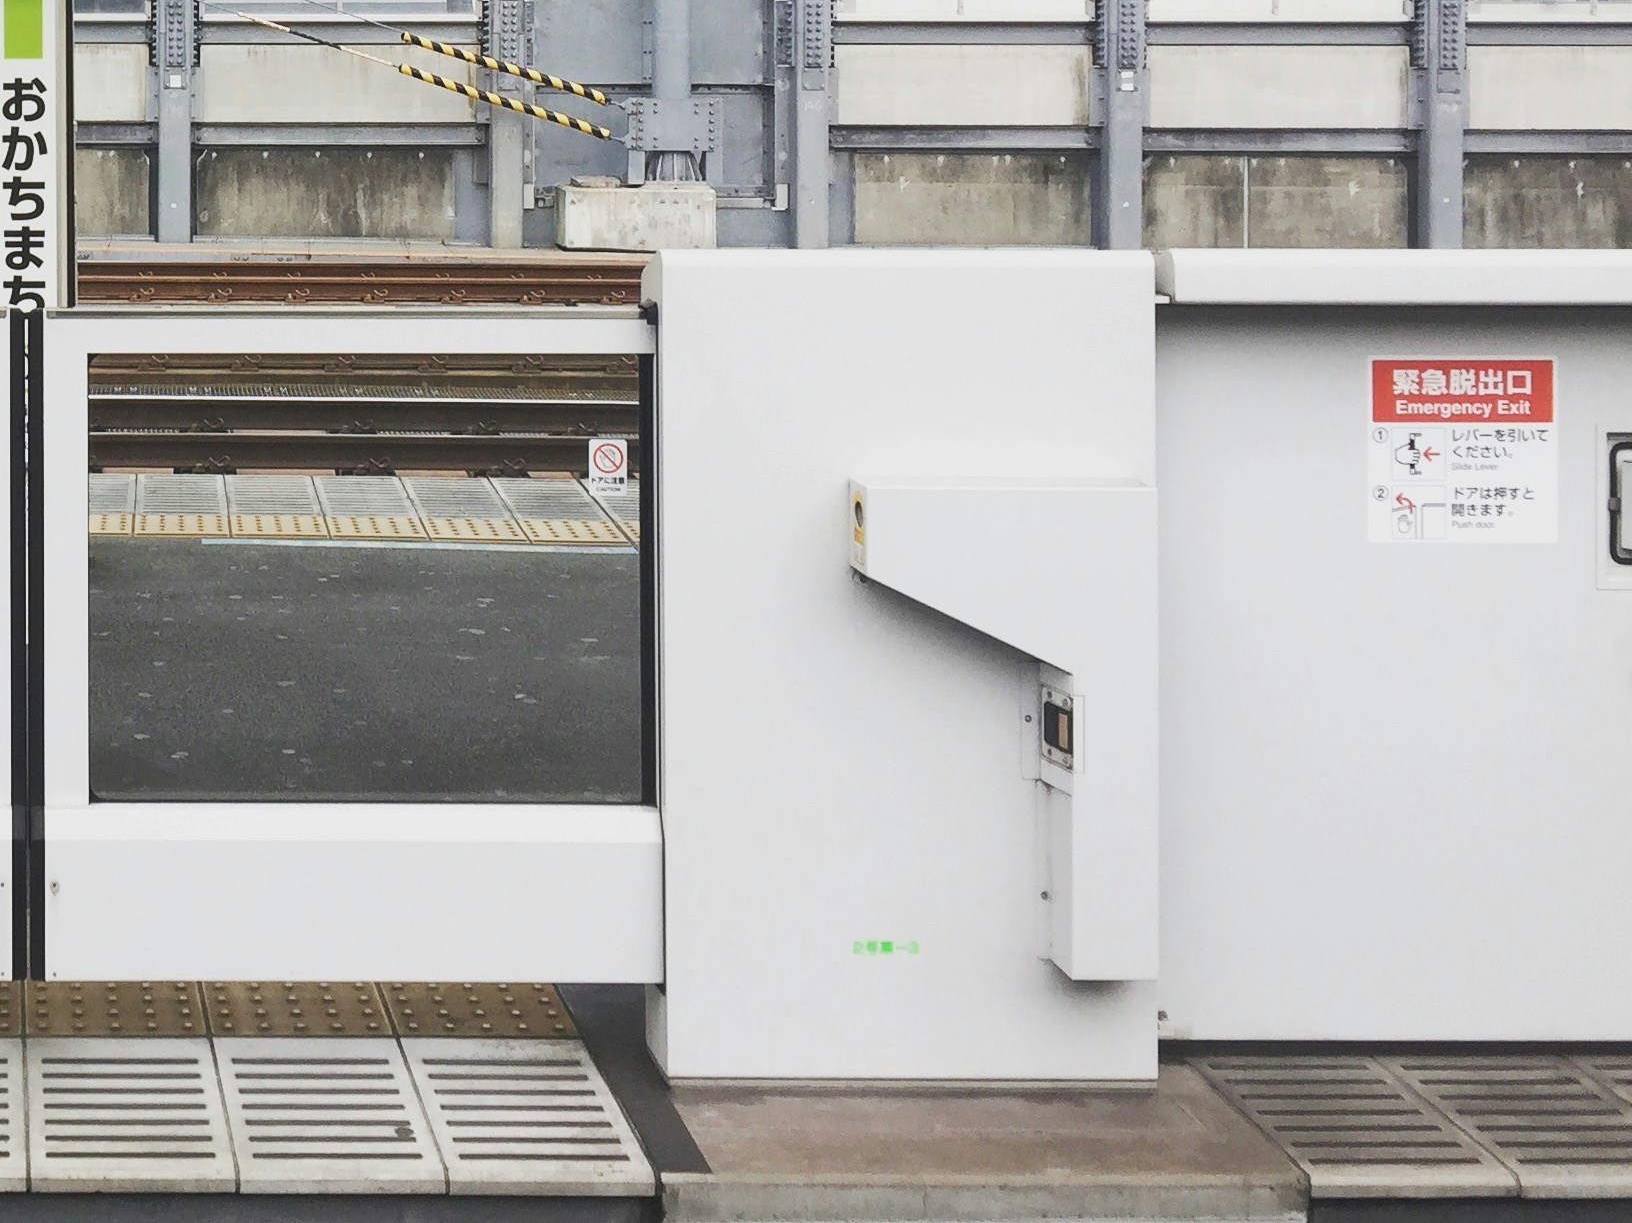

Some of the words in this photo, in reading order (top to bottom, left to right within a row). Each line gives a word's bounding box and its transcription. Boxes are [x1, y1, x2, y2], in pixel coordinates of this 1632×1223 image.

[1, 77, 48, 315] おかちまち
[1392, 368, 1533, 396] 緊急脱出口
[1395, 400, 1493, 418] Emergency
[1497, 400, 1531, 415] Exit
[1451, 428, 1550, 443] レバーを引いて
[1452, 487, 1535, 501] ドアは押すと
